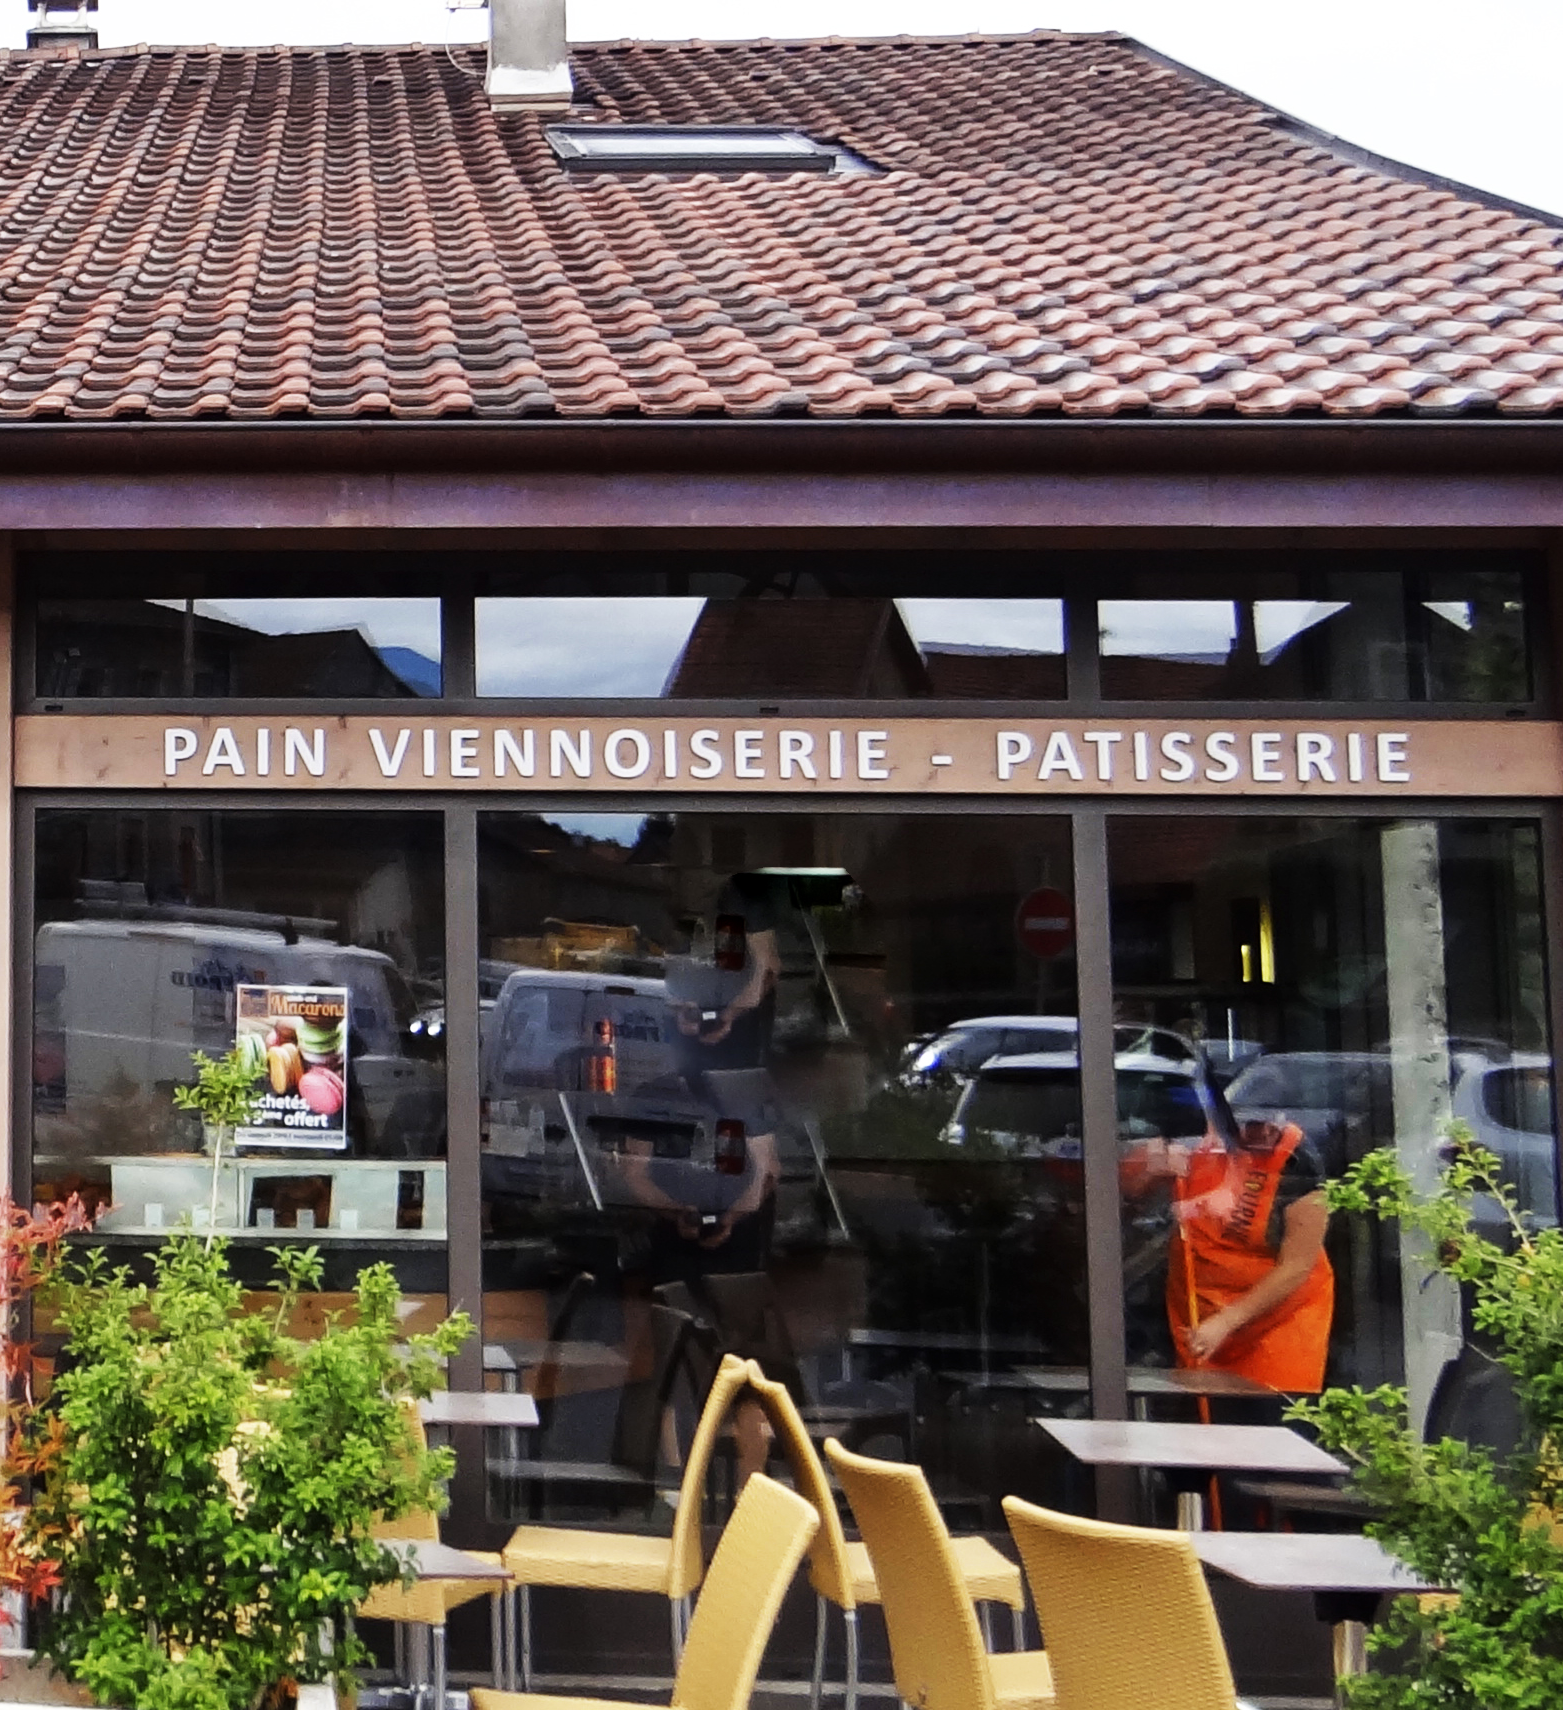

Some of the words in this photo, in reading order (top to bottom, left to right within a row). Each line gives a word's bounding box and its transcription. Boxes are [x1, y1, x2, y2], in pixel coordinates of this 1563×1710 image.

[163, 727, 325, 777] PAIN
[368, 728, 890, 780] VIENNOISERIE
[931, 755, 953, 766] -
[996, 731, 1411, 782] PATISSERIE
[284, 1111, 329, 1128] offert
